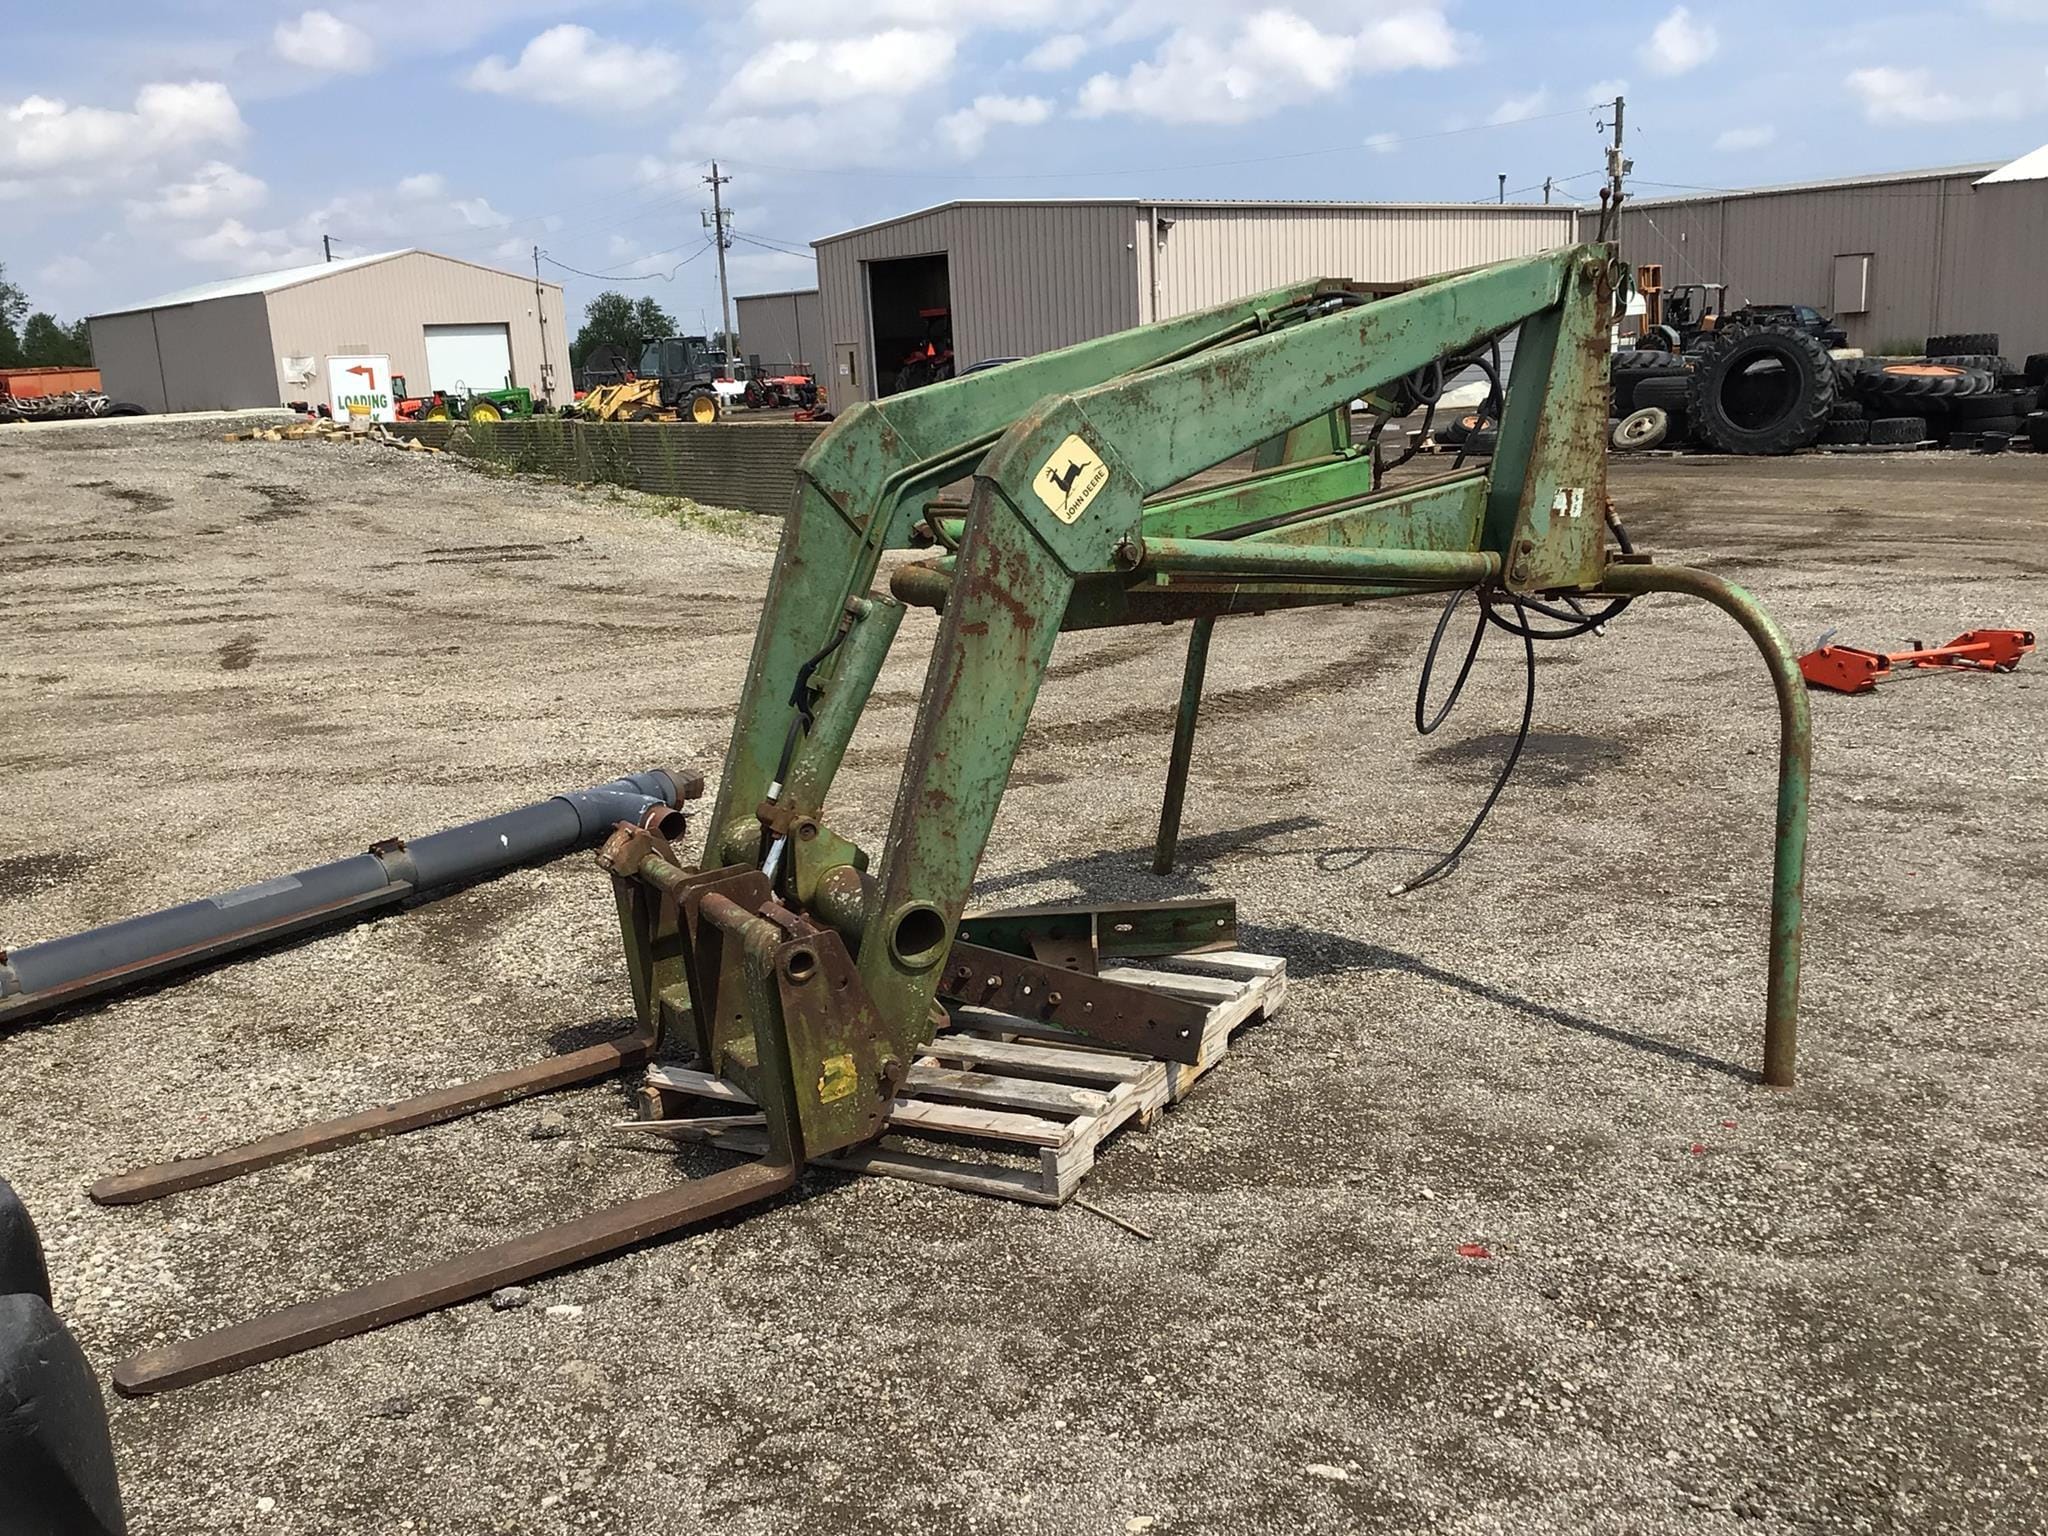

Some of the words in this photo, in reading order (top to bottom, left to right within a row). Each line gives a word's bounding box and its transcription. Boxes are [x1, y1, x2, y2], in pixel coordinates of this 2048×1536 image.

[338, 394, 387, 410] LOADING
[1065, 496, 1085, 519] JOHN
[1083, 470, 1105, 497] DEERE
